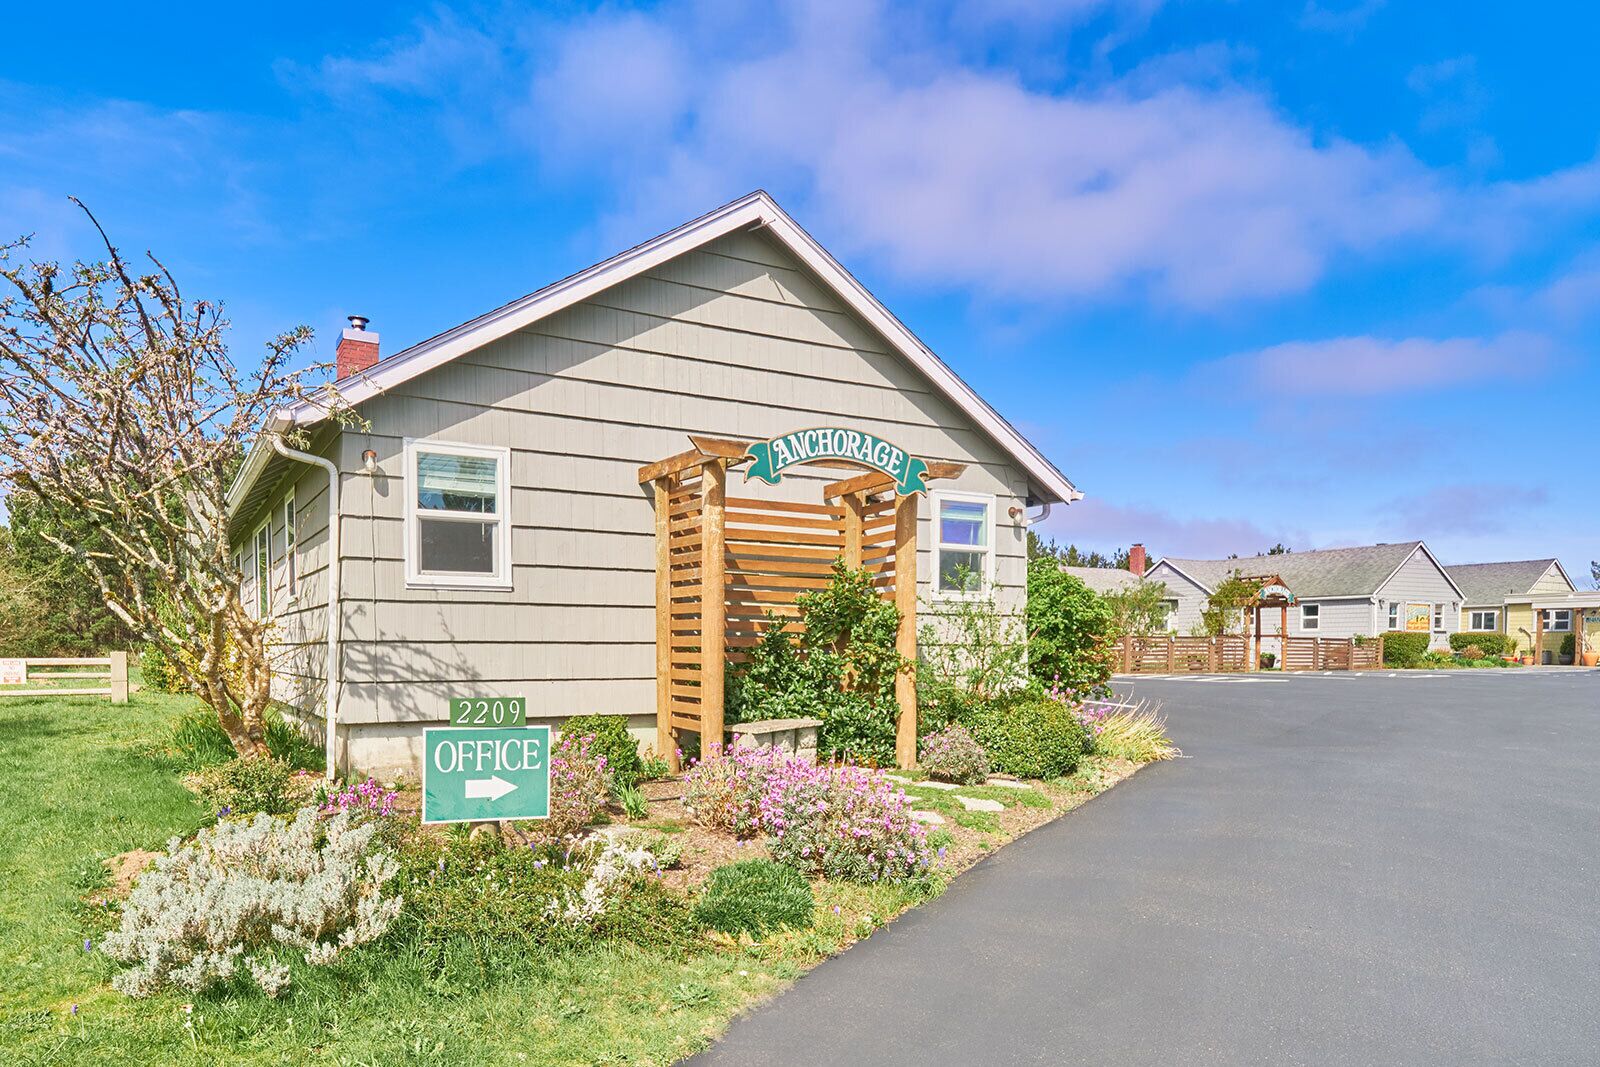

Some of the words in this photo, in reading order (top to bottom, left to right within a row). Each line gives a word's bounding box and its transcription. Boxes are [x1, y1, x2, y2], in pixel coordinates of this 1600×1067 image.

[773, 428, 903, 475] ANCHORAGE
[456, 700, 520, 724] 2209
[434, 738, 541, 773] OFFICE
